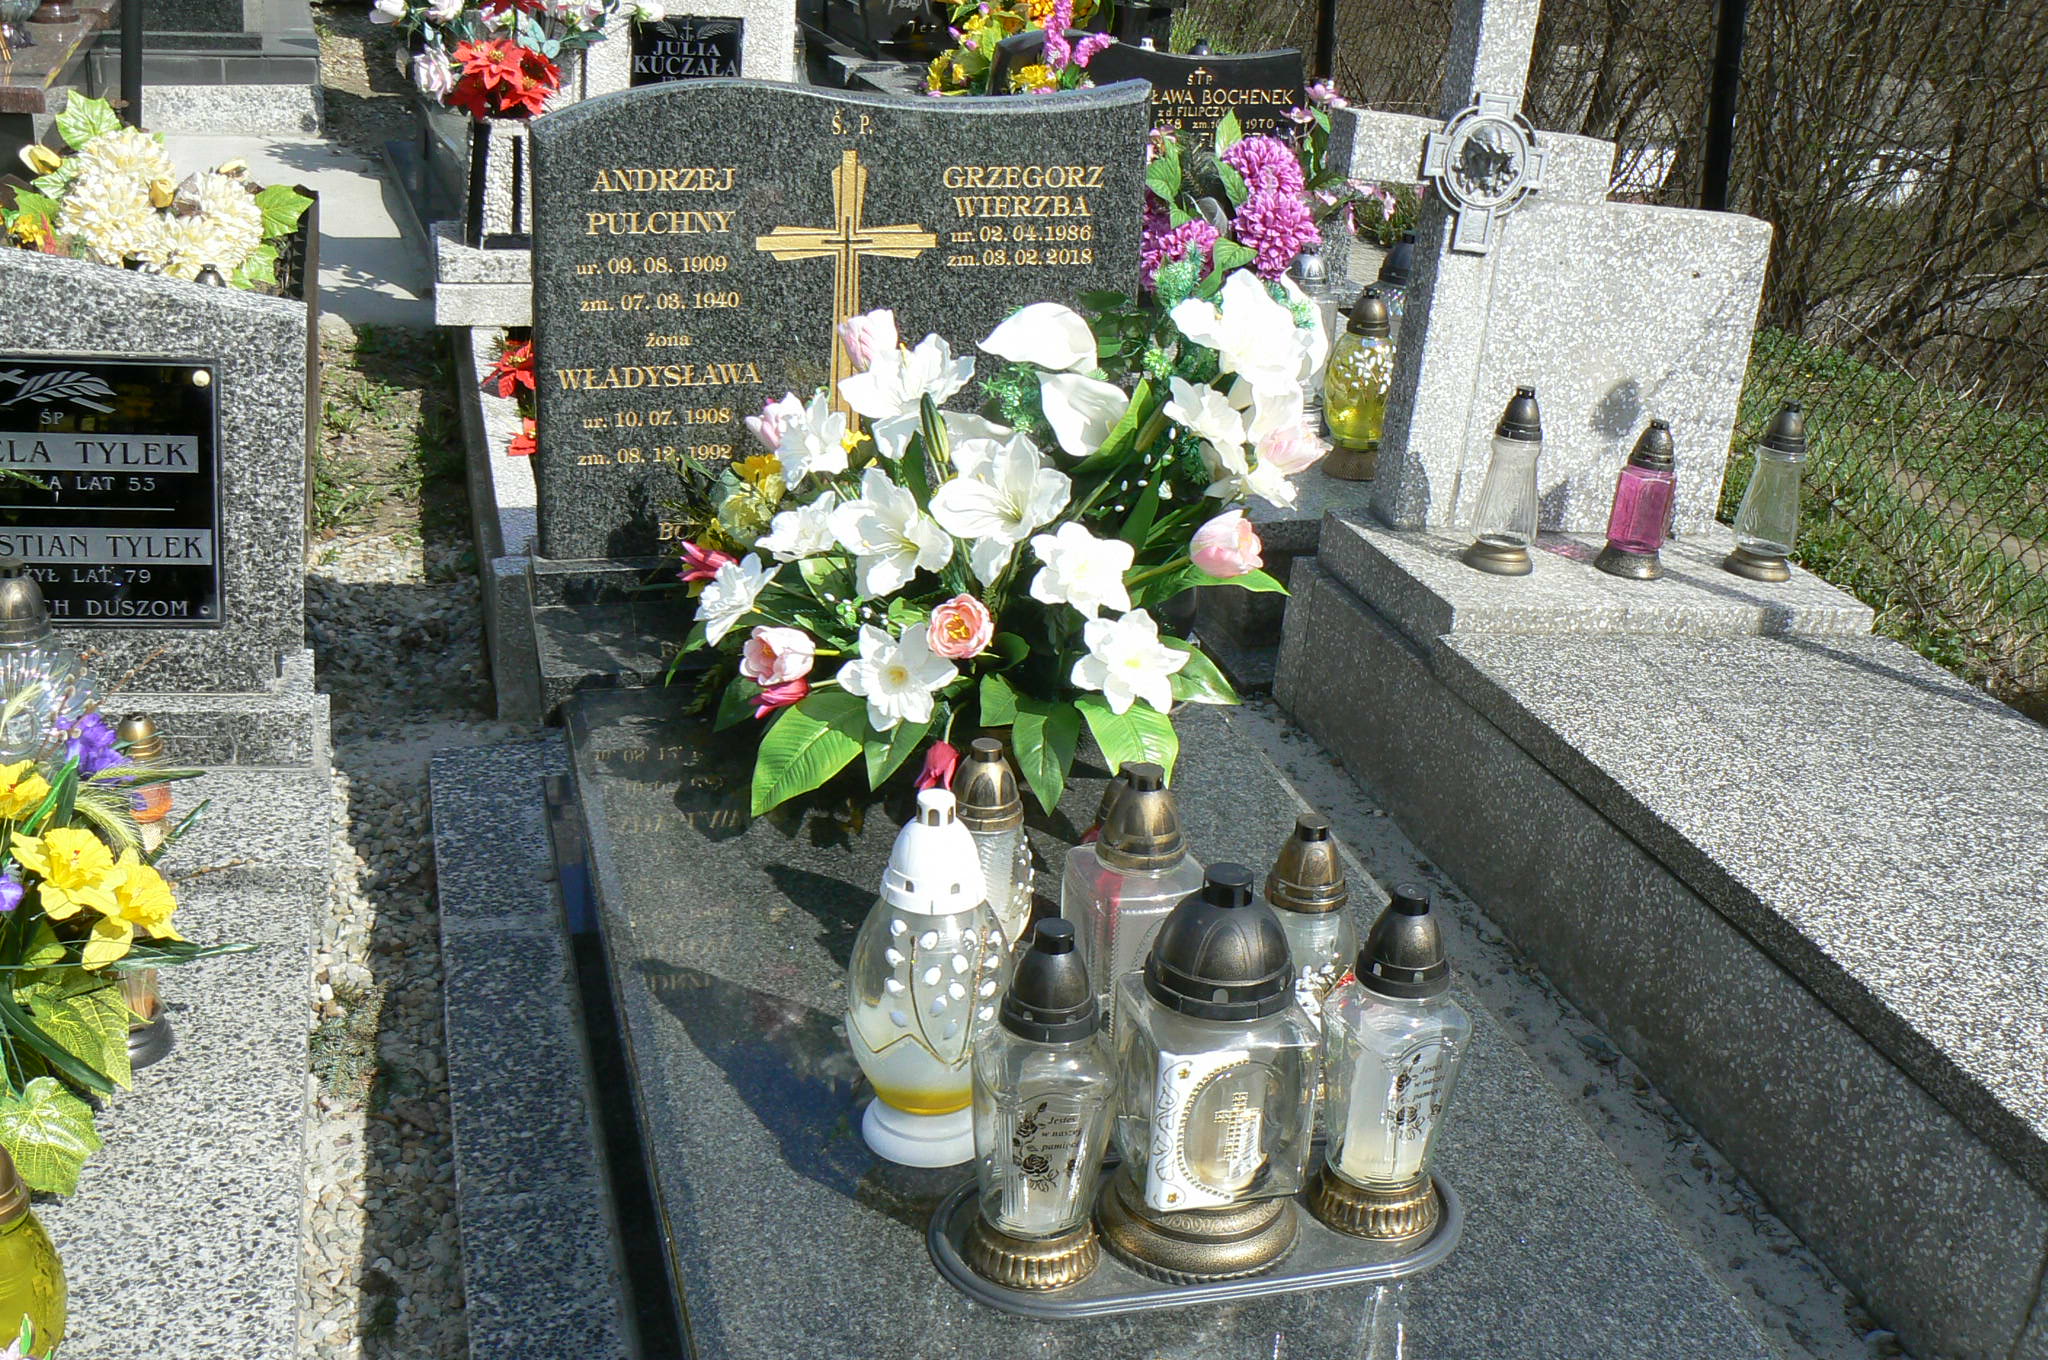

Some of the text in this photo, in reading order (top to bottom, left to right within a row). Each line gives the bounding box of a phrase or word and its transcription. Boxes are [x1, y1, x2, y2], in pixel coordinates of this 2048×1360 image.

[652, 41, 721, 57] JULIA
[634, 55, 740, 77] KUCZAŁA
[1202, 89, 1294, 105] BOCHENEK
[1246, 118, 1275, 129] 1970
[590, 168, 736, 192] ANDRZEJ
[943, 165, 1105, 189] GRZEGORZ
[953, 196, 1093, 218] WIERZBA
[585, 210, 736, 235] PULCHNY
[577, 255, 727, 275] ur. 09. 08. 1909
[1046, 248, 1093, 265] 2018
[580, 292, 740, 312] zm. 07. 03. 1940
[645, 332, 692, 347] żona
[557, 362, 763, 390] WŁADYSŁAWA
[582, 407, 732, 429] ur. 10. 07. 1908
[75, 441, 188, 466] TYLEK
[576, 453, 612, 466] zm.
[617, 447, 646, 464] 08.
[688, 443, 733, 461] 1992
[76, 476, 115, 491] LAT
[128, 477, 156, 492] 53
[0, 535, 203, 558] STIAN TYLEK
[73, 569, 112, 583] LAT
[125, 569, 151, 583] 79
[87, 600, 188, 617] DUSZOM
